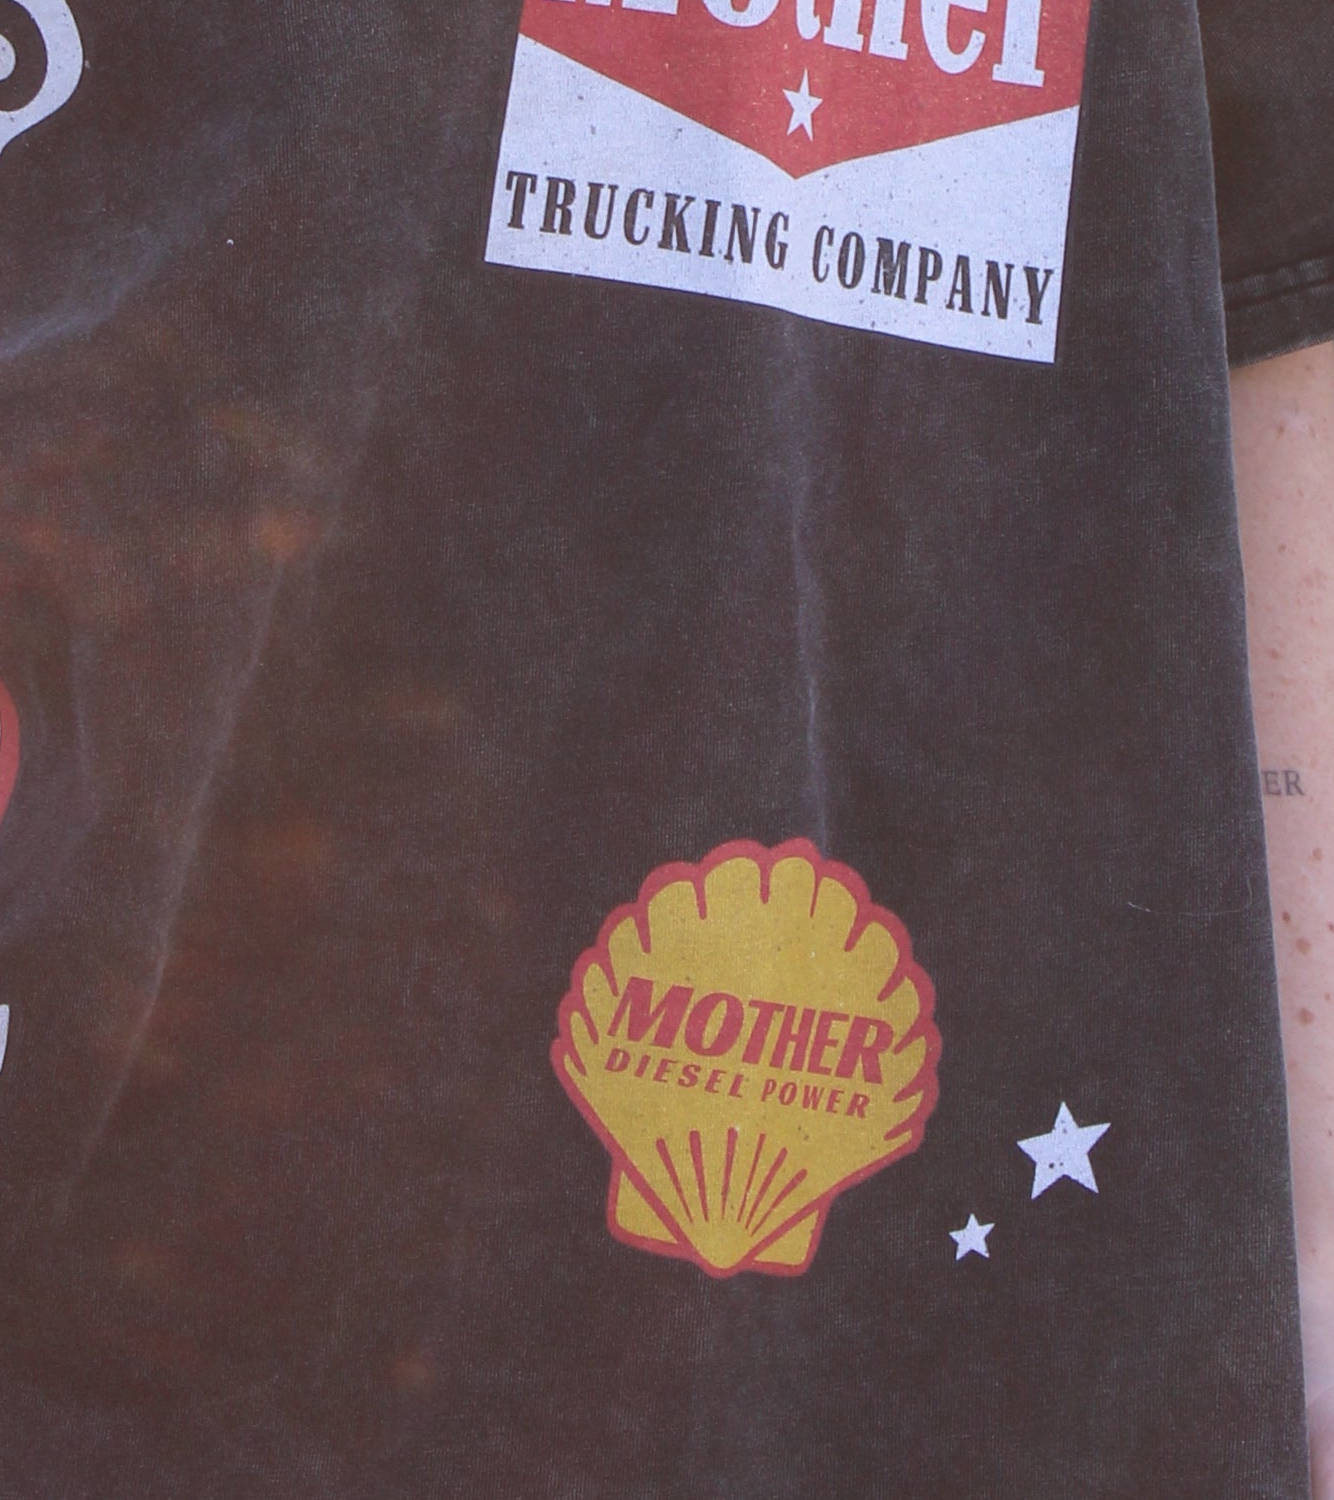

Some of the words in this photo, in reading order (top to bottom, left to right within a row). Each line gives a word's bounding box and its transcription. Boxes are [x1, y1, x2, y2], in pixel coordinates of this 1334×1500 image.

[504, 169, 791, 272] TRUCKING
[811, 224, 1055, 326] COMPANY
[603, 1047, 746, 1099] DIESEL
[760, 1077, 871, 1119] POWER
[606, 975, 895, 1085] MOTHER
